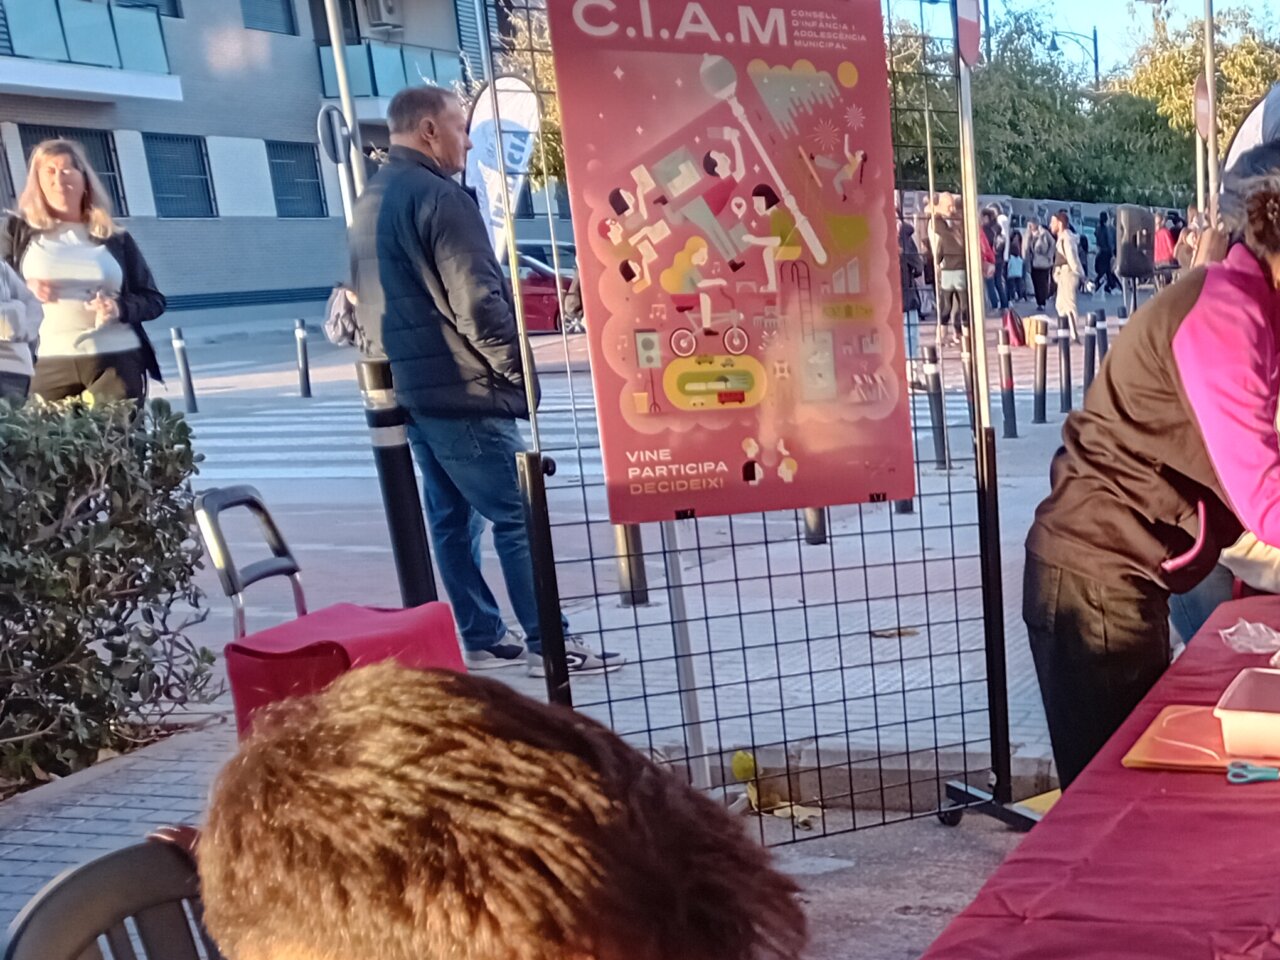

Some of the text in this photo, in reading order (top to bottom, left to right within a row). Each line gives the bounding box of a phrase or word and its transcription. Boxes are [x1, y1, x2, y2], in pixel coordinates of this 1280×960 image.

[790, 9, 838, 20] CONSELL
[793, 39, 848, 50] MUNICIPAL
[626, 448, 672, 463] VINE
[628, 460, 728, 479] PARTICIPA
